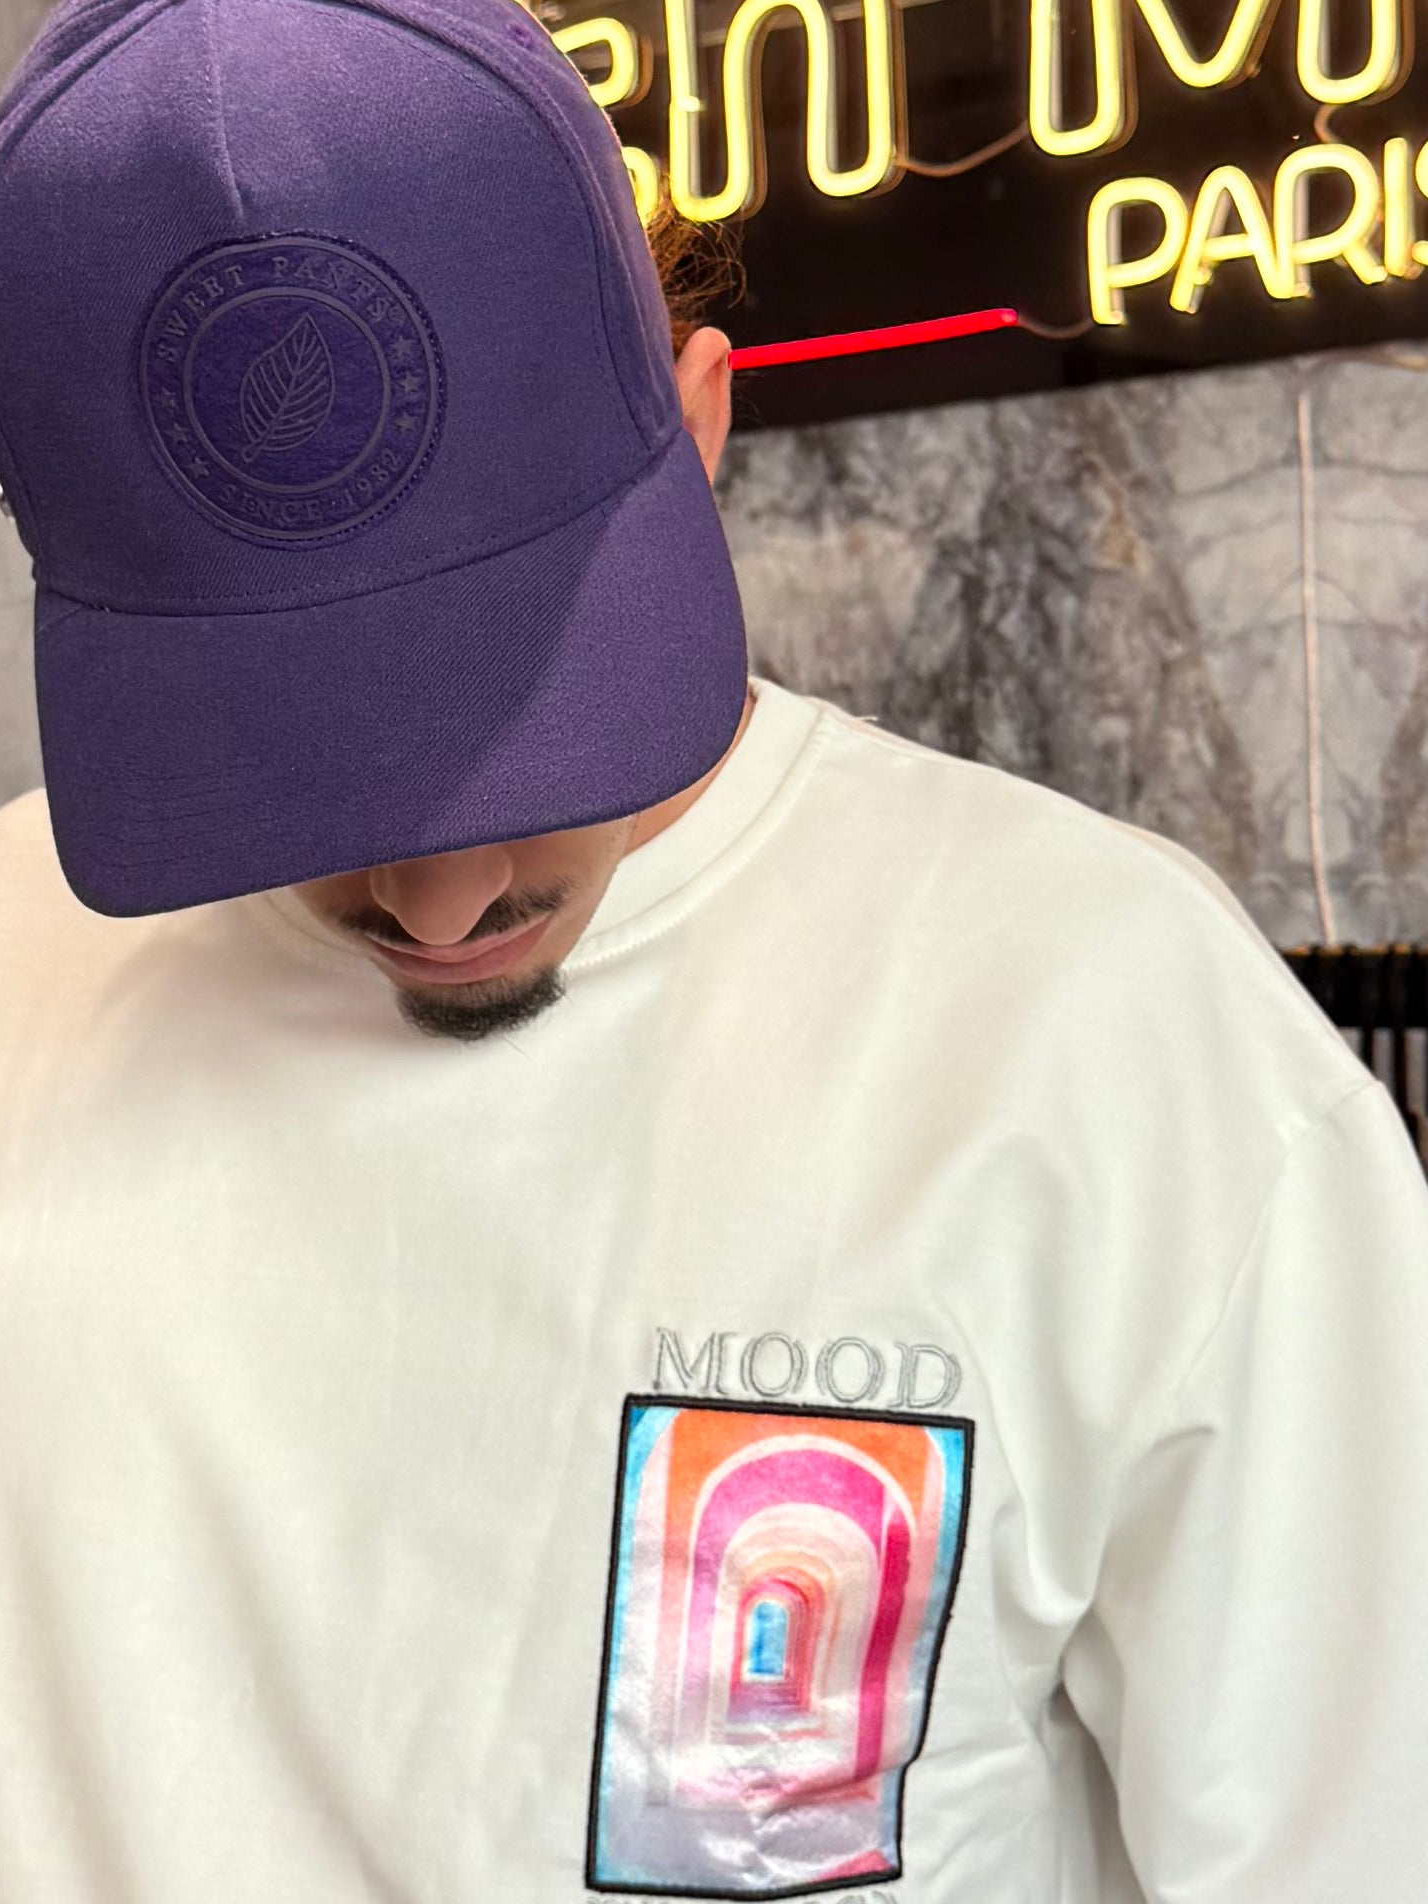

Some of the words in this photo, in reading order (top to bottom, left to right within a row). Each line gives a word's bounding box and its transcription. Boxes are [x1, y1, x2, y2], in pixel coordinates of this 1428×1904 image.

[156, 263, 244, 365] SWEET
[345, 449, 404, 508] 1982
[651, 1326, 963, 1410] MOOD
